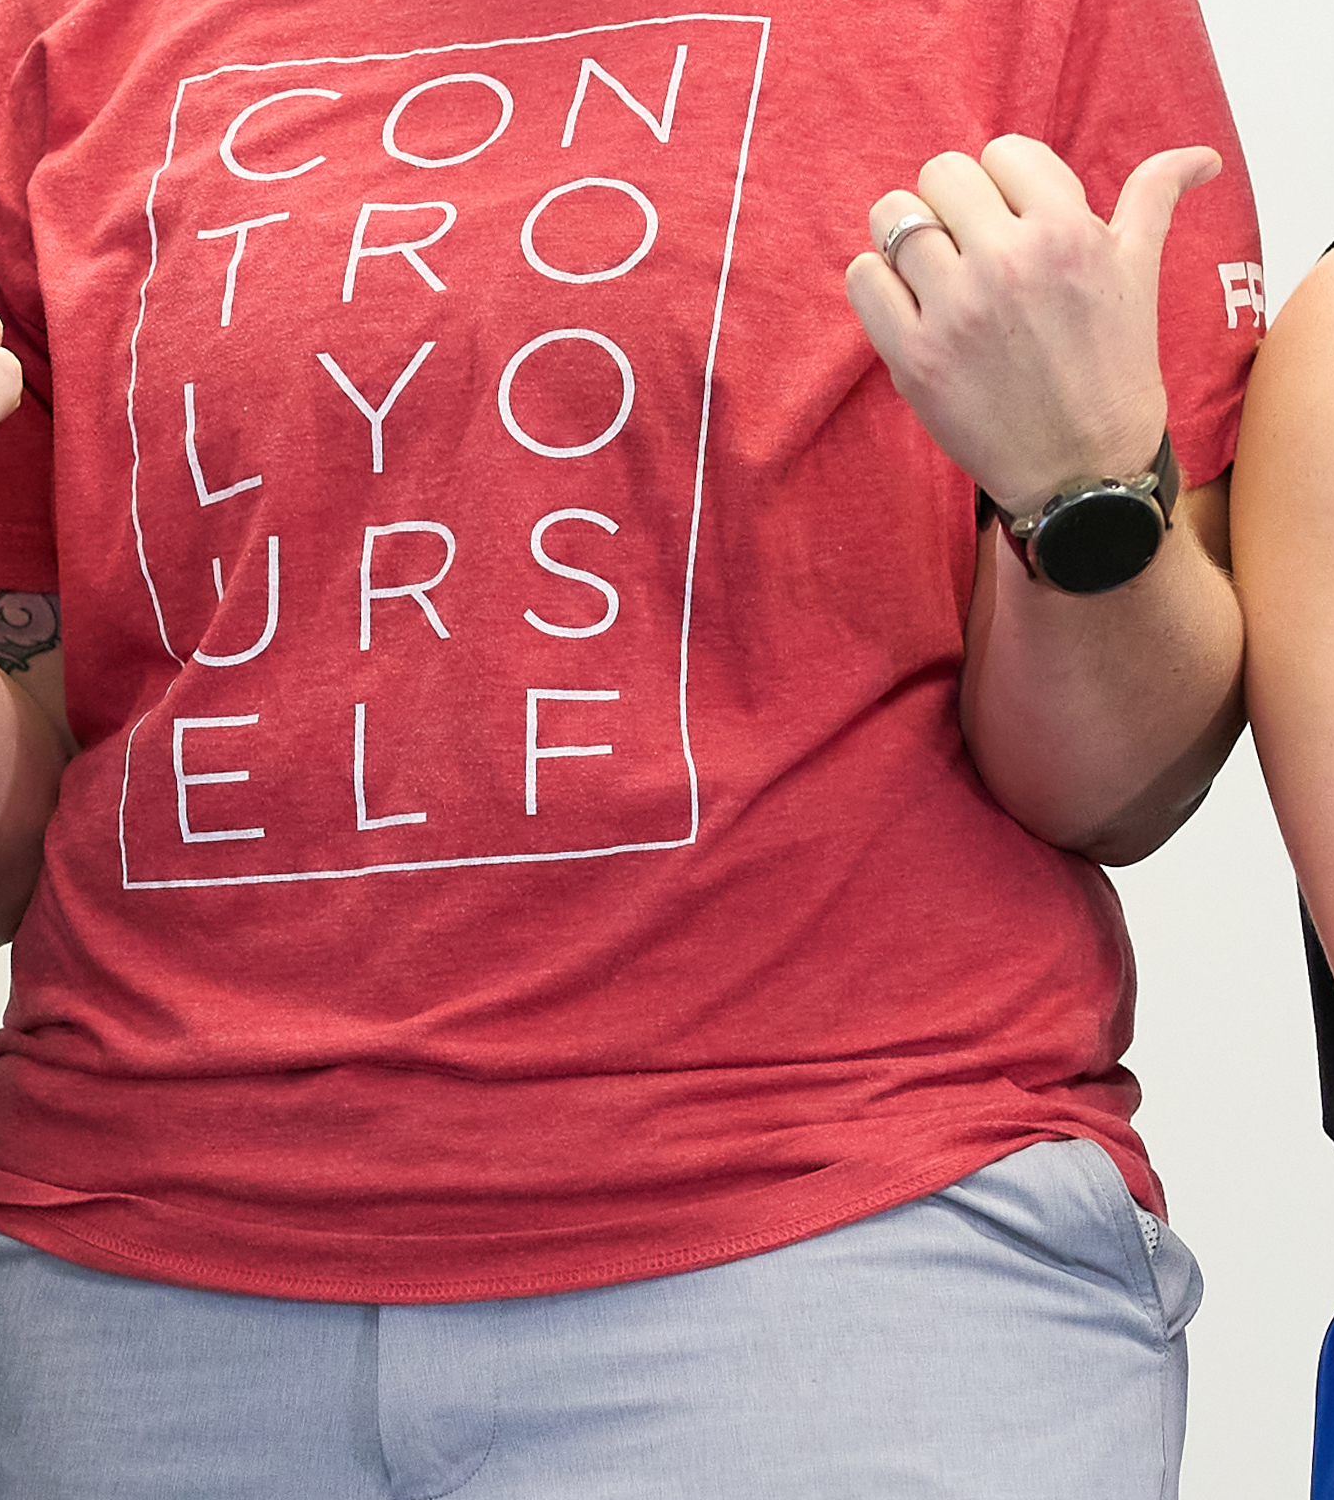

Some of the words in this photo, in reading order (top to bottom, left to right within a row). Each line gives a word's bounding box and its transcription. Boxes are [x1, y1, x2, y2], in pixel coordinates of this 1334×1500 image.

[218, 45, 688, 182] CON
[197, 177, 658, 328] TRO
[183, 329, 636, 507] LYO
[192, 508, 620, 666] URS
[173, 688, 621, 843] ELF
